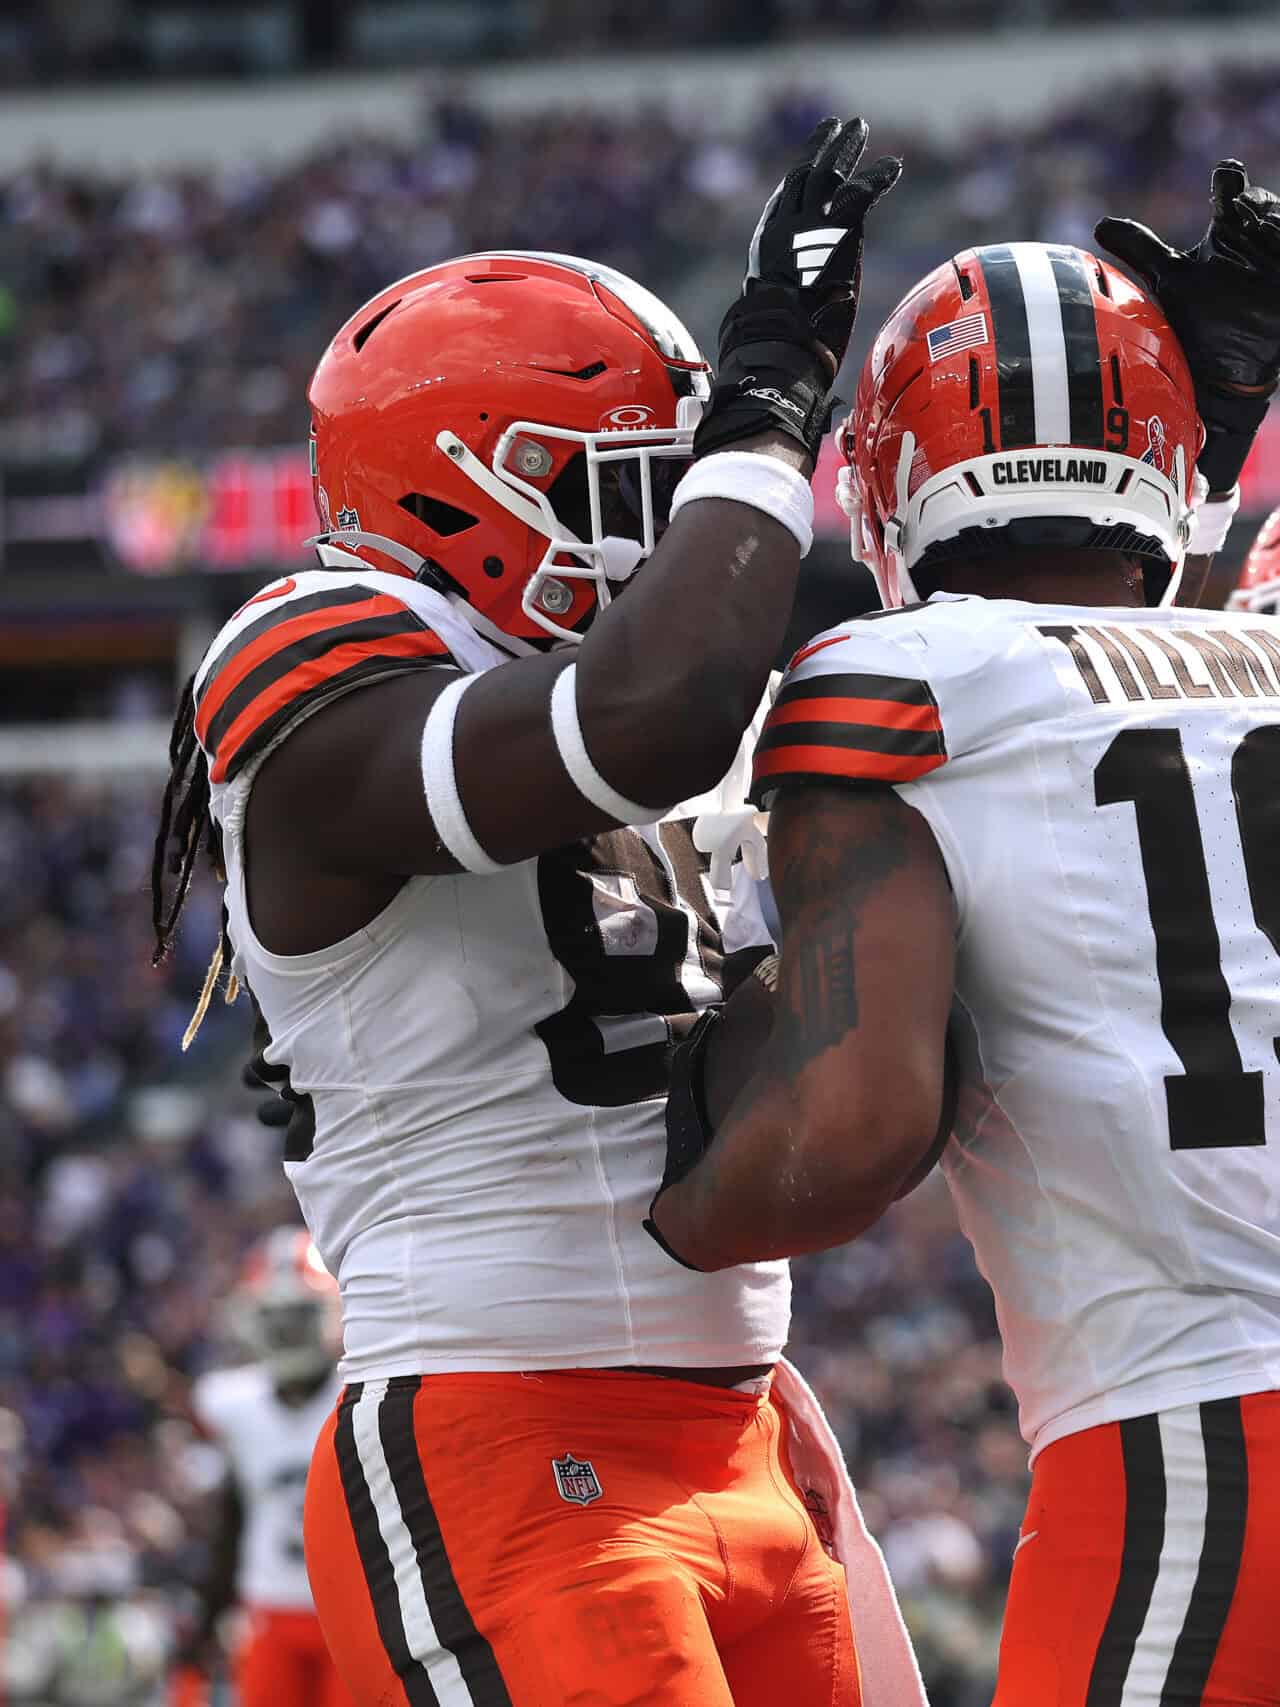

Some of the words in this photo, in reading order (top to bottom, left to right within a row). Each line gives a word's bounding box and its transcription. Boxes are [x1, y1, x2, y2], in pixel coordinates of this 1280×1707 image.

[1105, 407, 1130, 452] 9
[992, 459, 1107, 485] CLEVELAND
[563, 1477, 595, 1497] NFL
